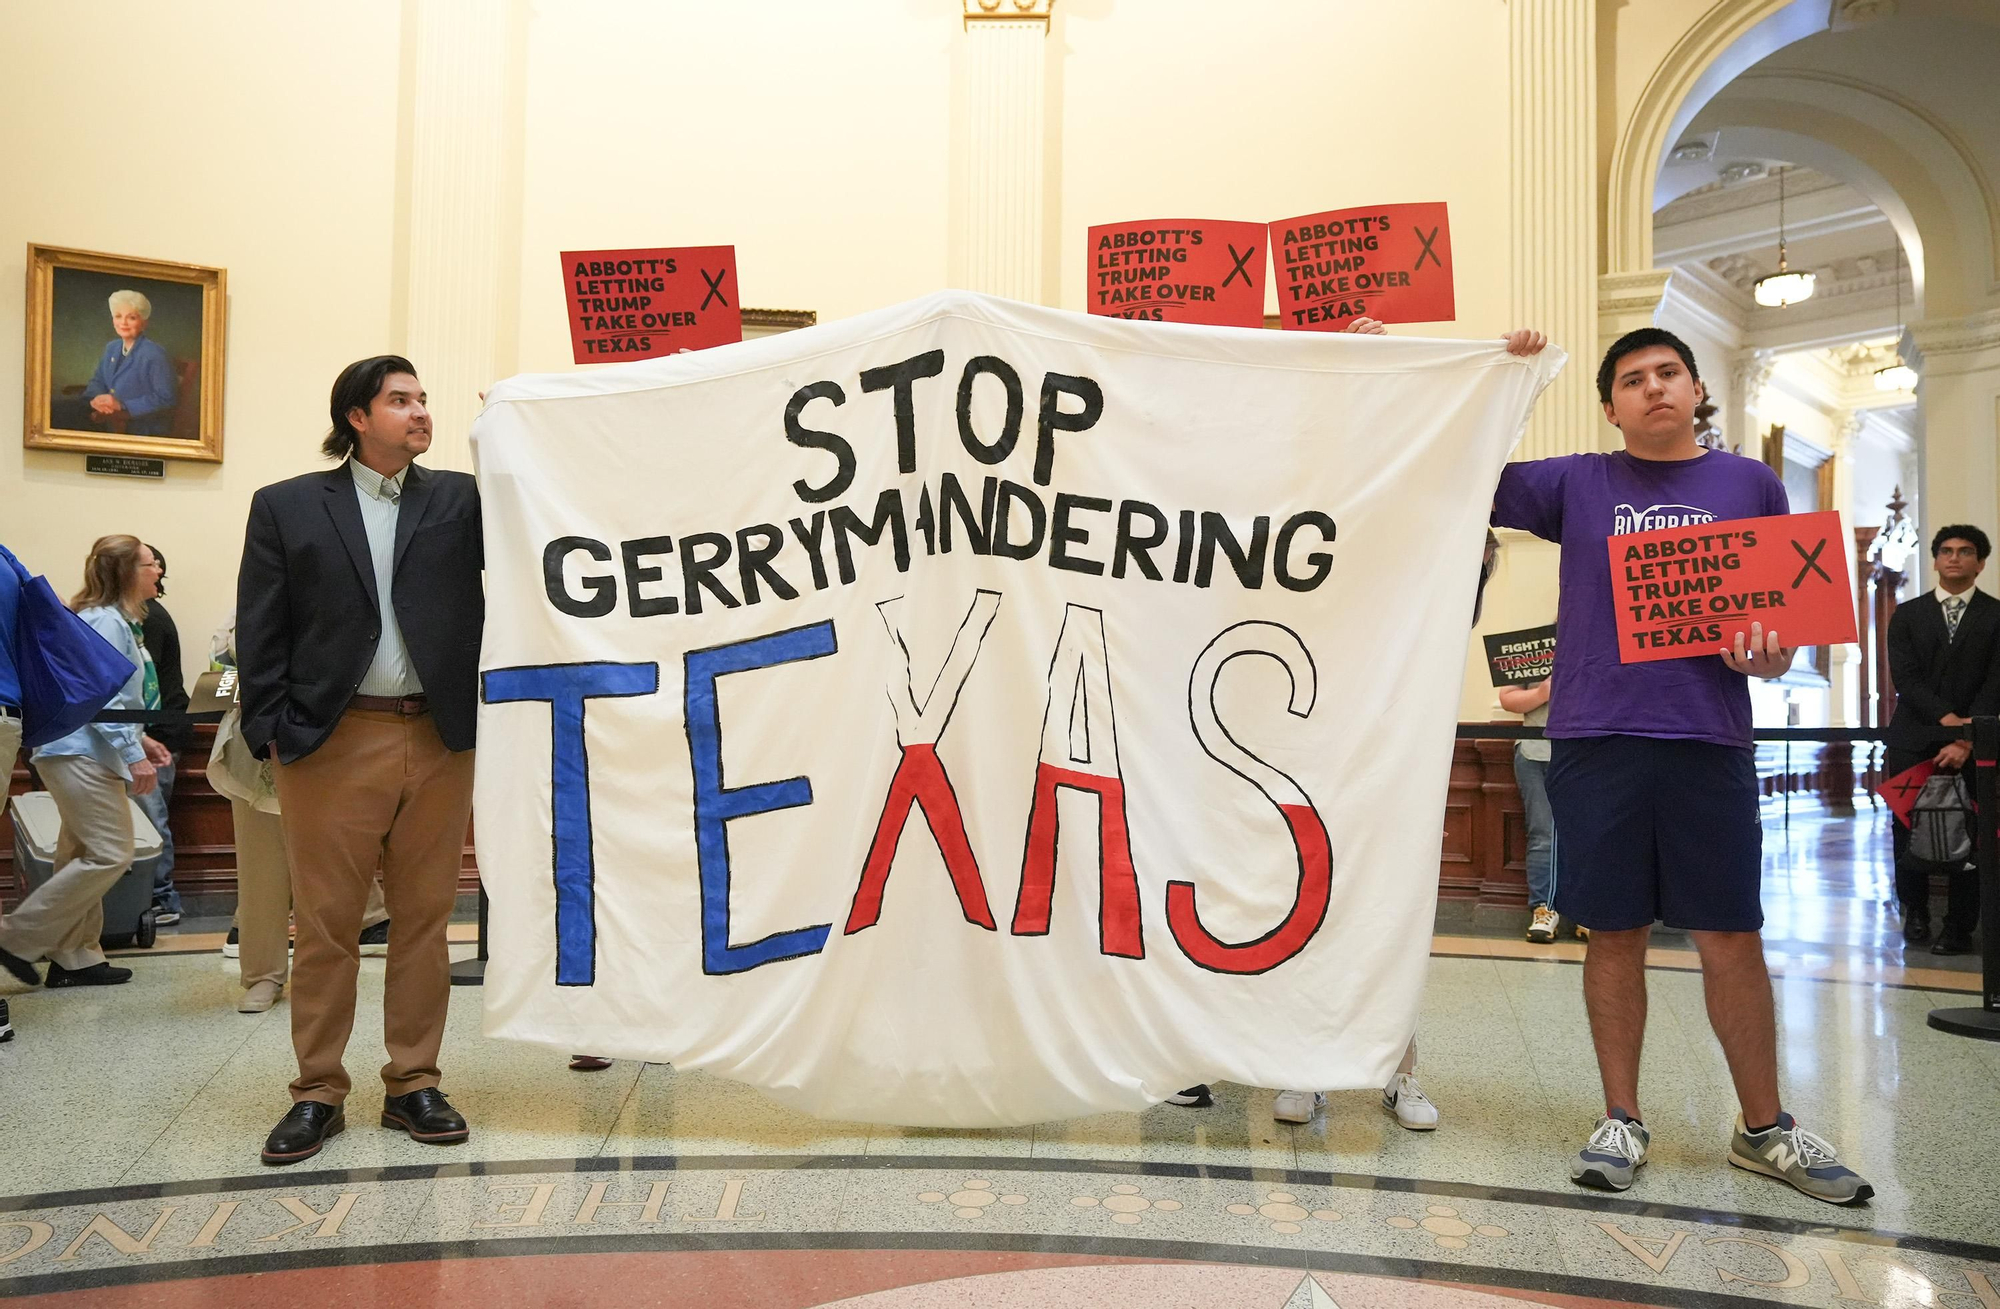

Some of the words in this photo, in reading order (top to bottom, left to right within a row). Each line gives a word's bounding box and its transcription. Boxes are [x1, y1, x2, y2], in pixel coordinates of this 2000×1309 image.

[1098, 230, 1203, 251] ABBOTT'S
[1283, 216, 1391, 246] ABBOTT'S
[1098, 248, 1187, 269] LETTING
[1284, 236, 1379, 264] LETTING
[574, 258, 677, 277] ABBOTT'S
[1098, 266, 1171, 287] TRUMP
[1286, 256, 1365, 282] TRUMP
[576, 278, 665, 296] LETTING
[1098, 285, 1152, 306] TAKE
[1156, 284, 1216, 301] OVER
[1289, 276, 1351, 301] TAKE
[1354, 271, 1411, 290] OVER
[578, 296, 652, 314] TRUMP
[1102, 308, 1163, 321] XAS
[1292, 299, 1366, 326] TEXAS
[580, 314, 637, 331] TAKE
[641, 311, 697, 327] OVER
[583, 337, 652, 354] TEXAS
[784, 349, 1104, 504] STOP
[542, 473, 1337, 619] GERRYMANDERING
[1624, 530, 1758, 563] ABBOTT'S
[1625, 553, 1741, 582] LETTING
[1627, 575, 1723, 602] TRUMP
[1629, 599, 1703, 623] TAKE
[1709, 590, 1787, 613] OVER
[1501, 640, 1540, 654] FIGHT
[1542, 637, 1557, 648] TH
[1632, 624, 1723, 650] TEXAS
[1505, 666, 1553, 680] TAKEO
[481, 589, 1333, 988] TEXAS
[470, 1178, 766, 1229] THE
